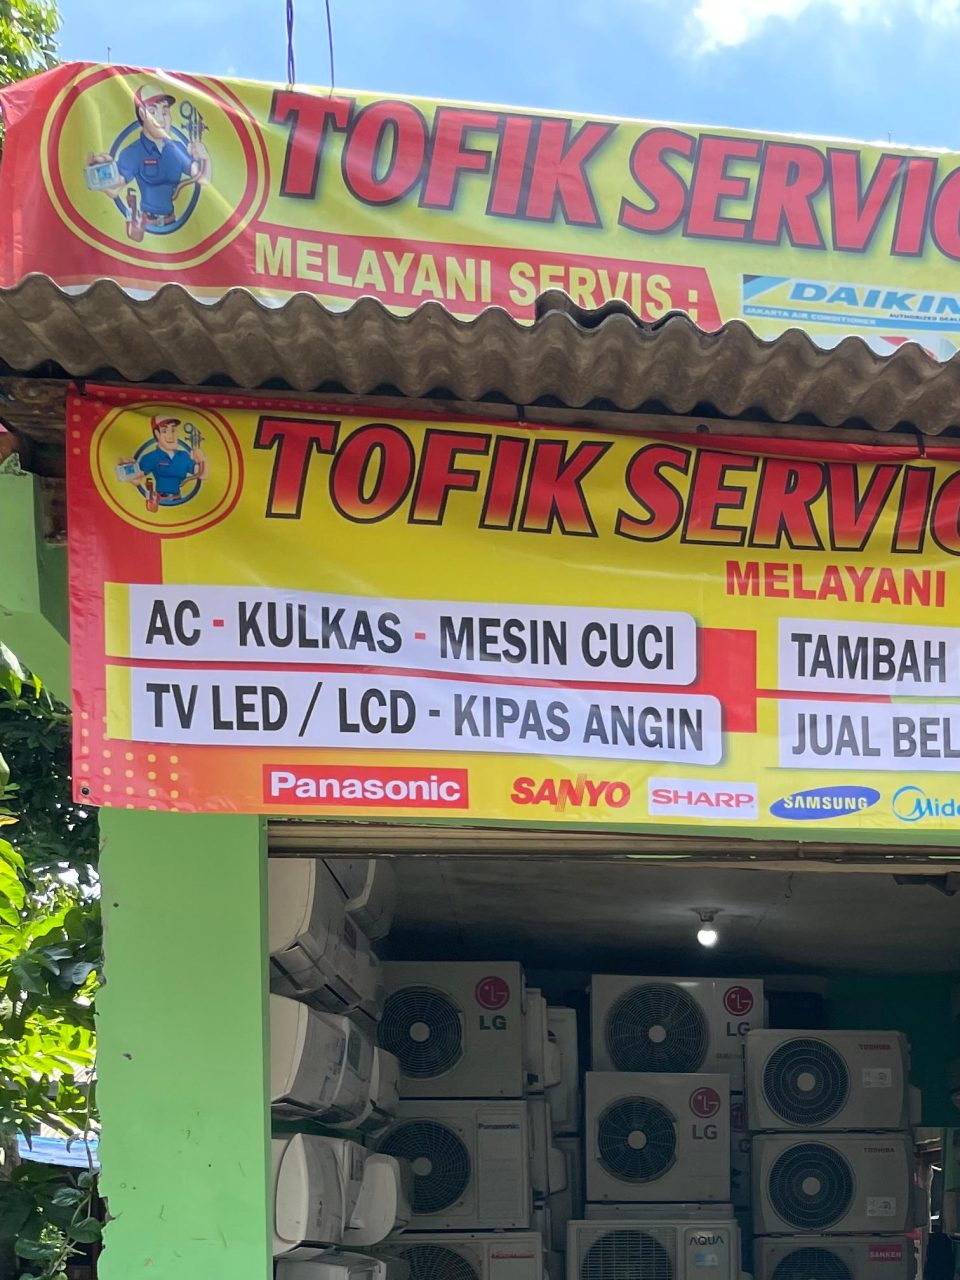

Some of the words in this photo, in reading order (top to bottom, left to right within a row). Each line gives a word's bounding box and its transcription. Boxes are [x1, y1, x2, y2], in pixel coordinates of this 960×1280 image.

[267, 90, 619, 230] TOFIK
[255, 232, 491, 303] MELAYANI
[746, 307, 788, 318] JAKARTA
[791, 312, 808, 320] AIR
[253, 415, 613, 538] TOFIK
[726, 560, 945, 608] MELAYANI
[146, 599, 200, 647] AC
[238, 601, 401, 653] KULKAS
[440, 615, 567, 665] MESIN
[581, 622, 674, 670] CUCI
[791, 633, 946, 684] TAMBAH
[146, 683, 197, 730] TV
[212, 684, 288, 732] LED
[338, 687, 415, 735] LCD
[453, 693, 570, 743] KIPAS
[583, 704, 703, 751] ANGIN
[792, 713, 880, 757] JUAL
[270, 771, 461, 803] Panasonic
[511, 775, 631, 812] SANYO
[652, 788, 755, 809] SHARP
[784, 794, 867, 811] SAMSUNG
[480, 1015, 507, 1031] LG
[726, 1022, 750, 1038] LG
[692, 1125, 718, 1140] LG
